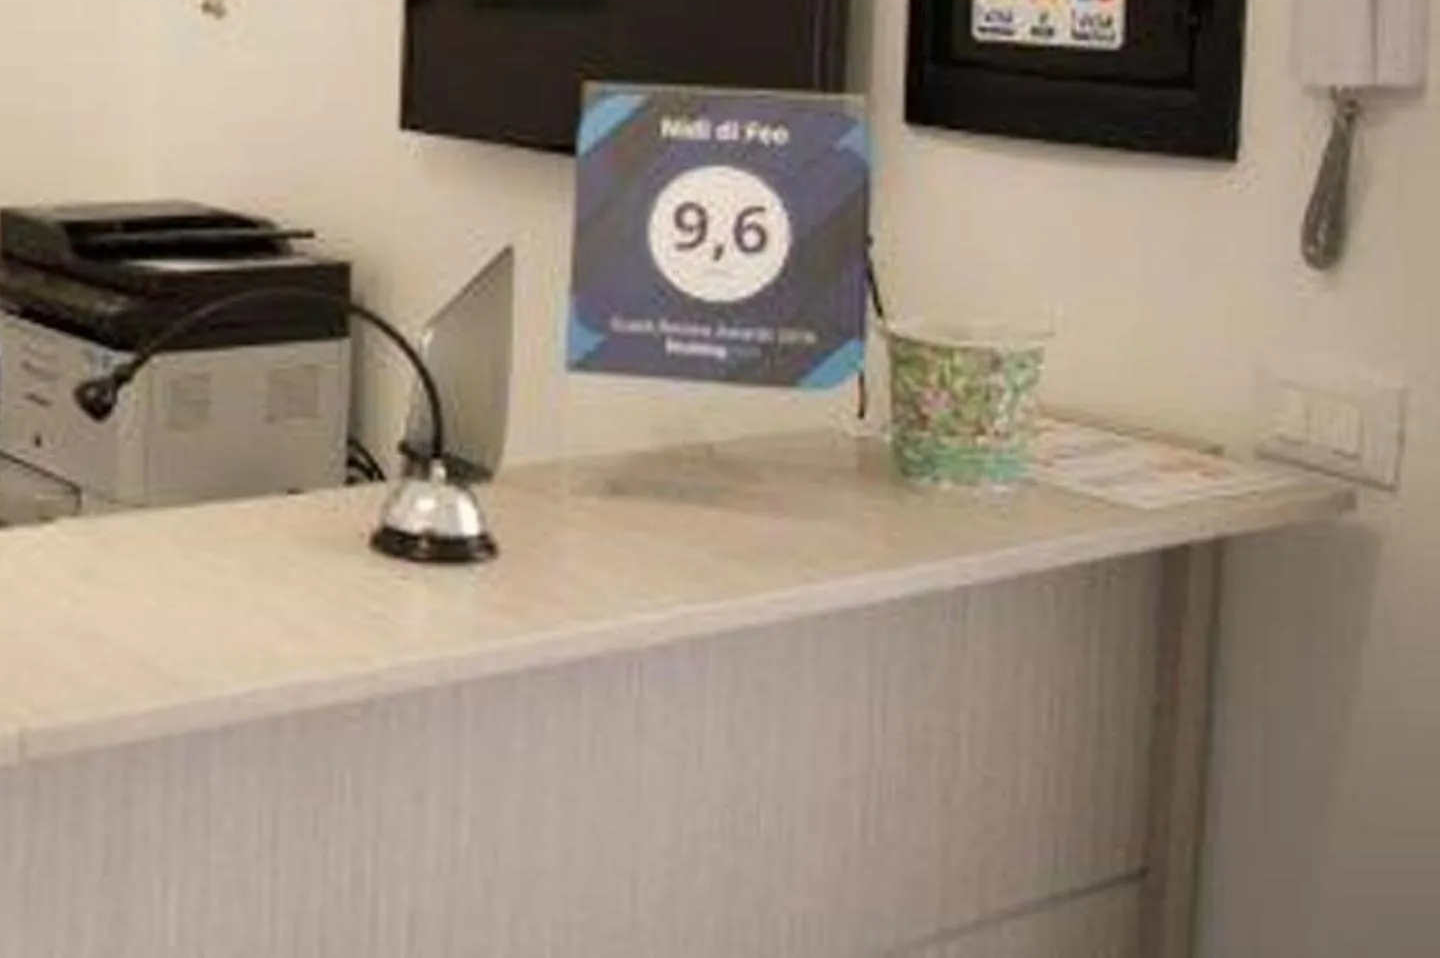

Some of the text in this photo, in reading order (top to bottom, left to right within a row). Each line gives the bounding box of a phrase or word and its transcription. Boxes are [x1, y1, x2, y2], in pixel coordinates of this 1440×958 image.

[660, 118, 711, 141] Nidi
[715, 120, 739, 141] di
[672, 201, 769, 262] 9,6
